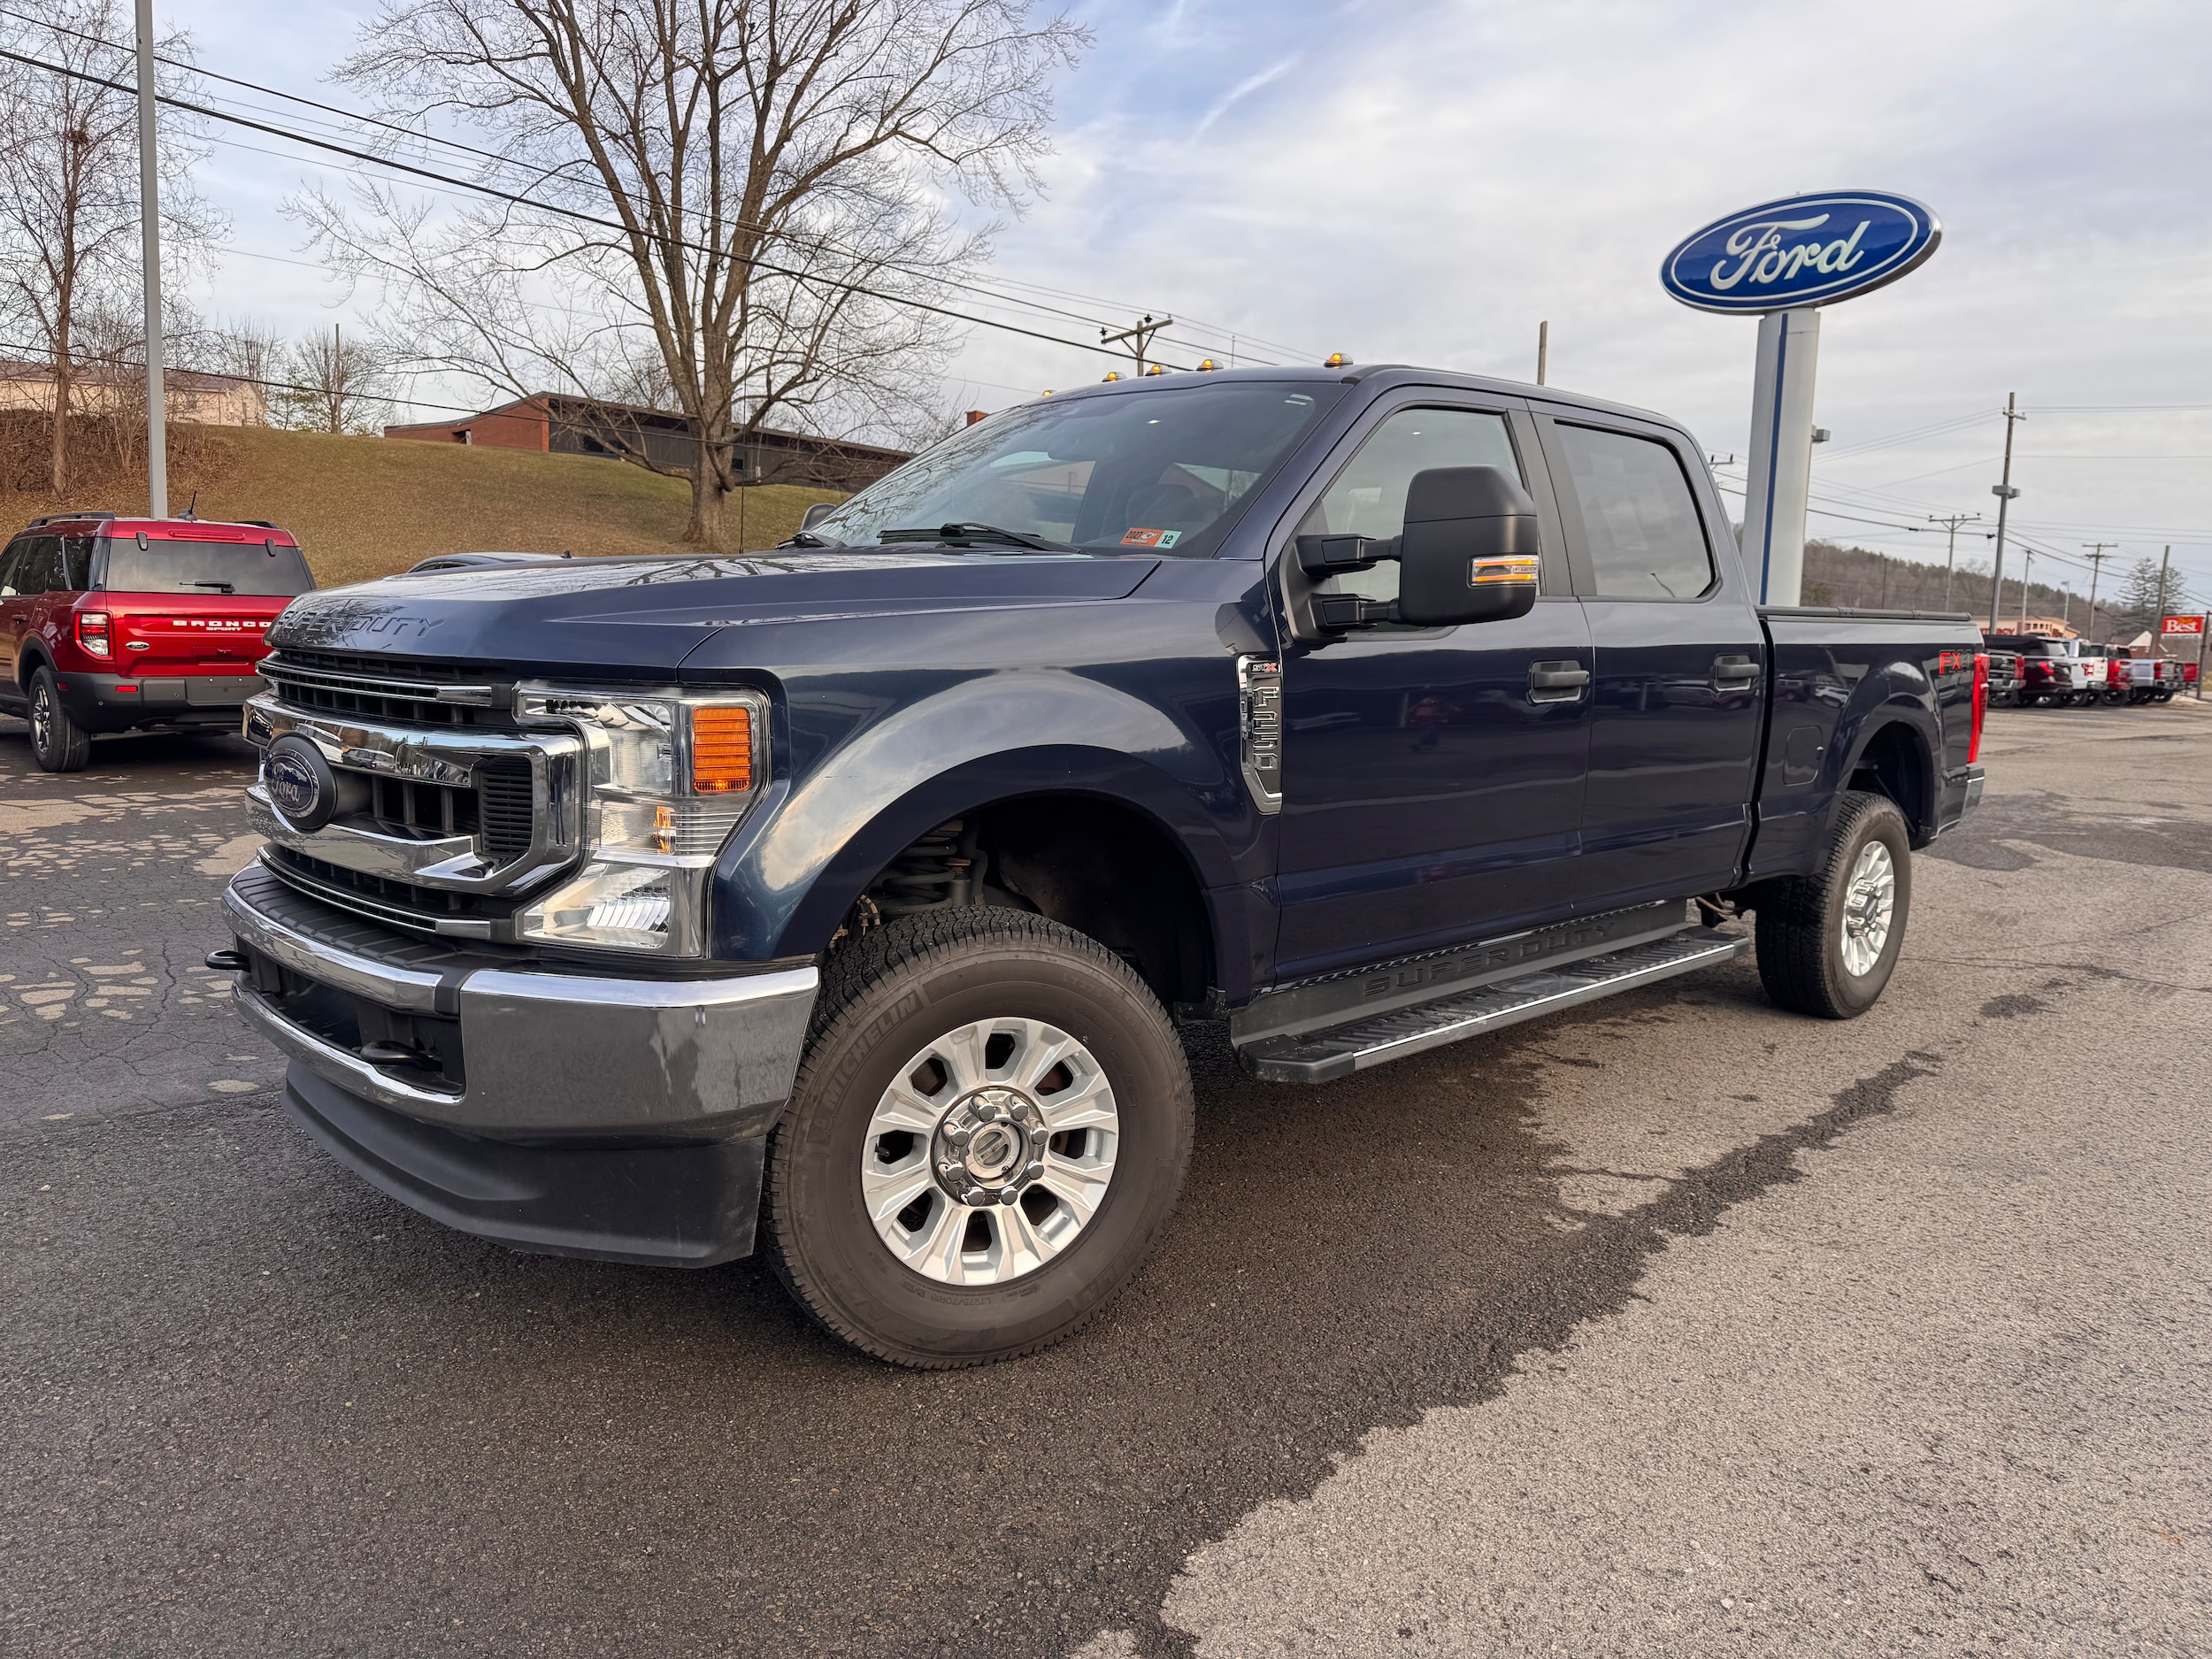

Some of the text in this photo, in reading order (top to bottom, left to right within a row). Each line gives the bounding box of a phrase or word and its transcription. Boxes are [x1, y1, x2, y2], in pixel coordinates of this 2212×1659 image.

[1709, 213, 1870, 290] Ford
[1161, 534, 1174, 544] 12
[173, 619, 273, 628] BRONCO
[343, 615, 446, 638] DUTY
[2166, 619, 2200, 633] Best
[1251, 664, 1278, 672] STX
[1939, 650, 1972, 675] FX4
[1363, 922, 1615, 997] SUPER DUTY
[821, 992, 918, 1111] MICHELIN
